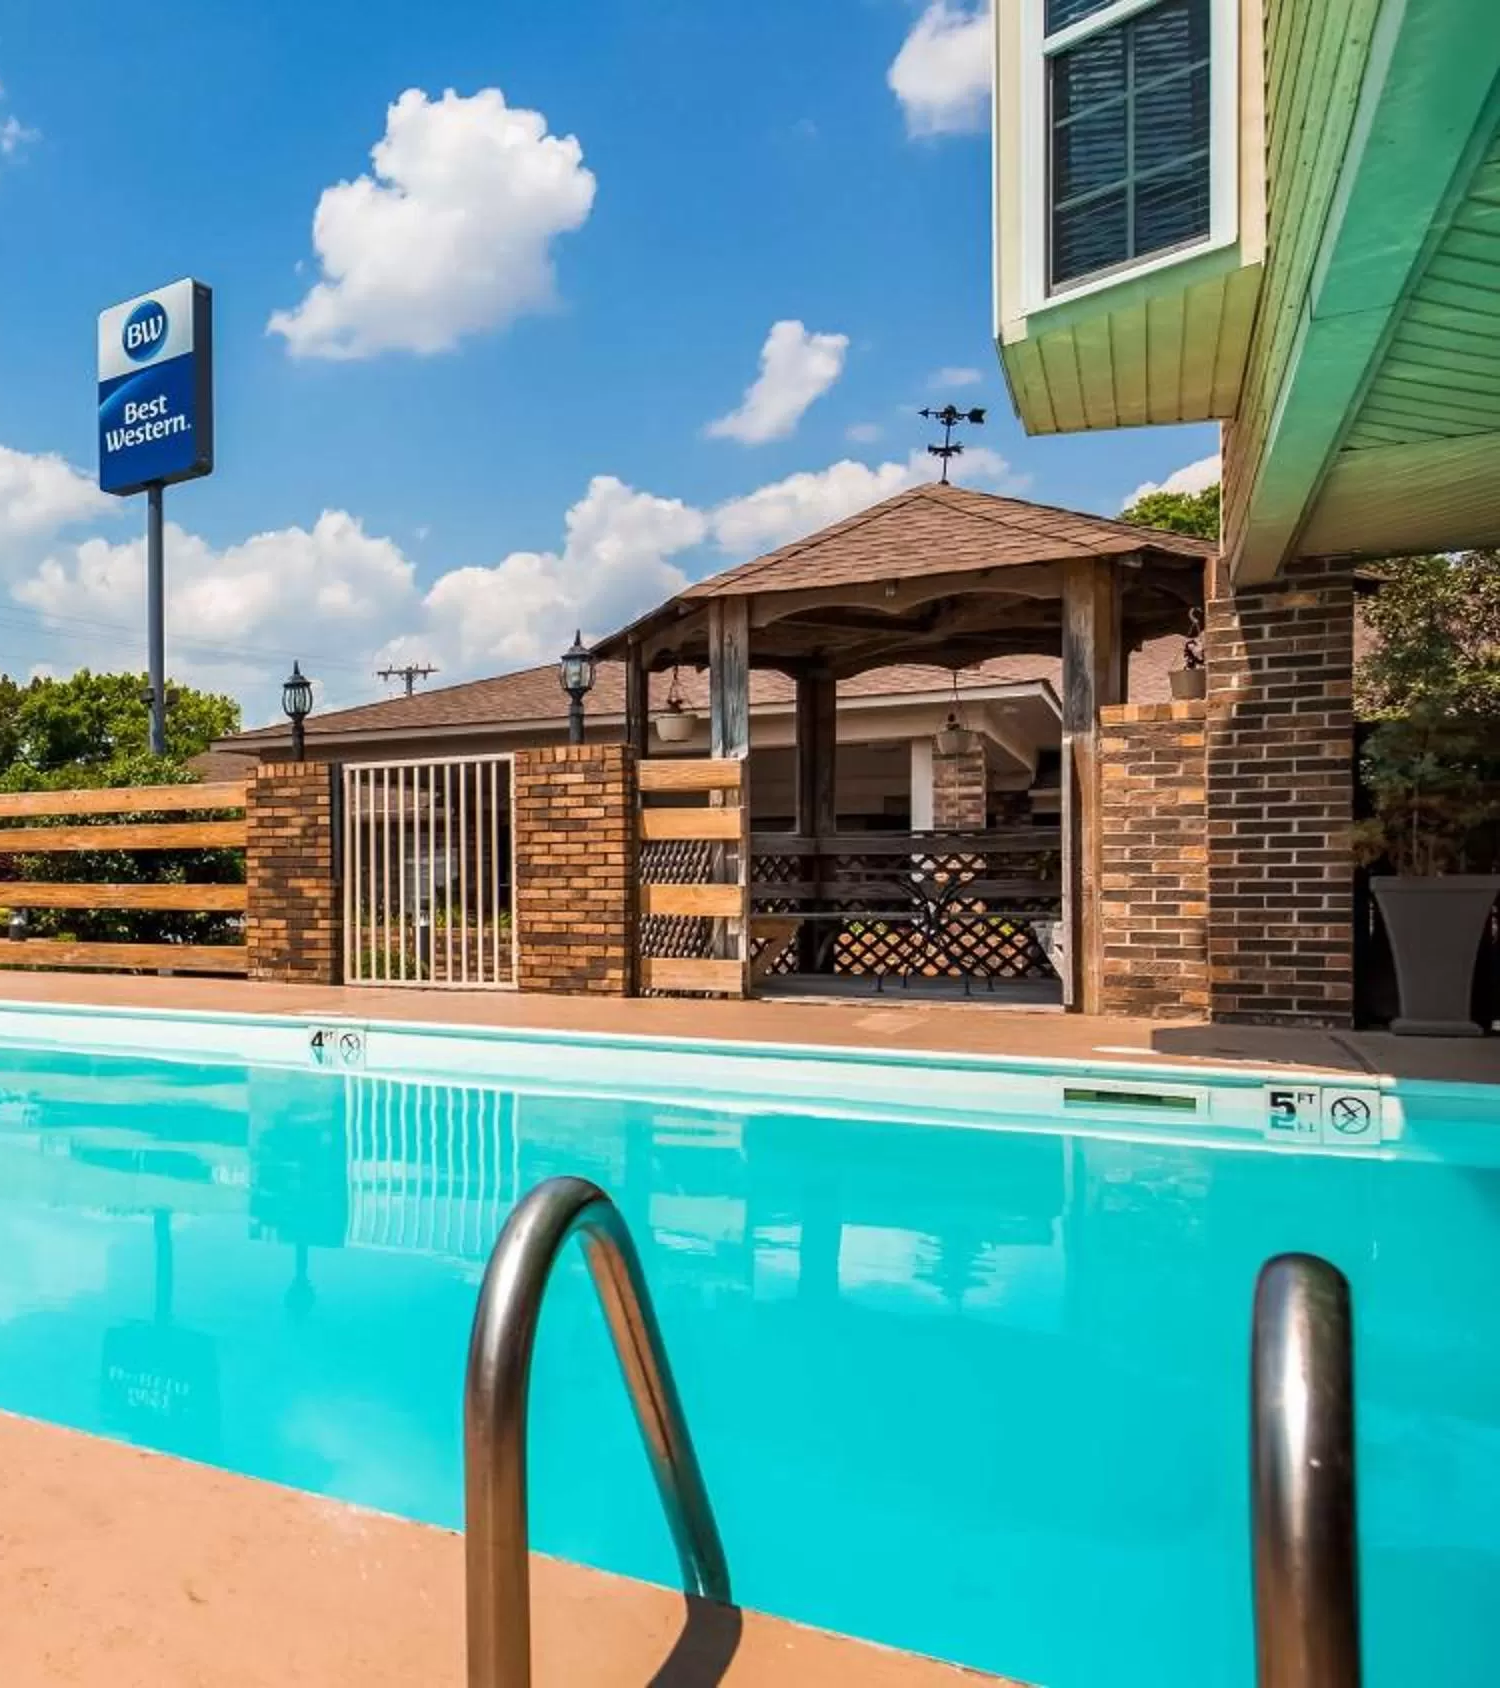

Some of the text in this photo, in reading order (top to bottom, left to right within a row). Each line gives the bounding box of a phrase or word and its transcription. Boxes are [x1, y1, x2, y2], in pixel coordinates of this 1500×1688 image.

[127, 315, 163, 349] BW
[125, 395, 168, 425] Best
[311, 1030, 324, 1047] 4
[1297, 1092, 1317, 1105] FT
